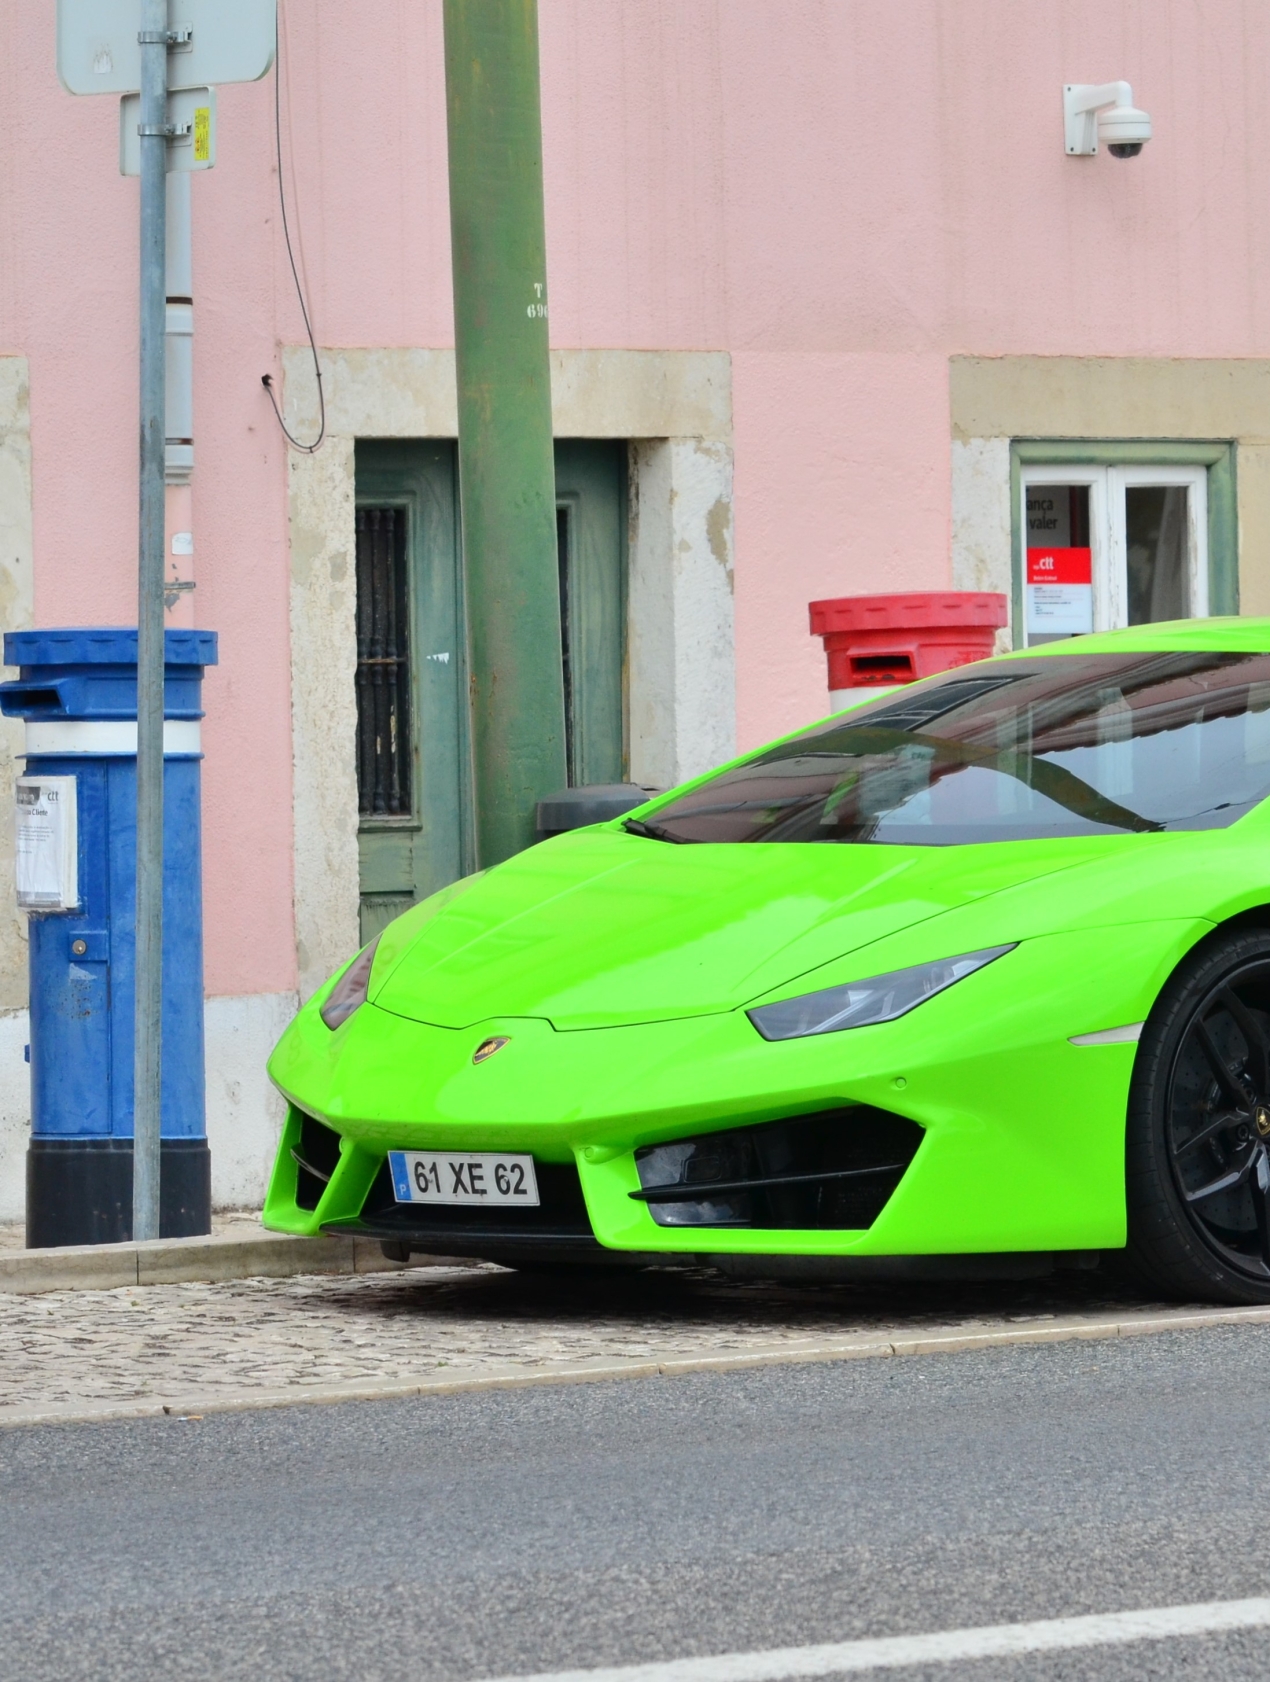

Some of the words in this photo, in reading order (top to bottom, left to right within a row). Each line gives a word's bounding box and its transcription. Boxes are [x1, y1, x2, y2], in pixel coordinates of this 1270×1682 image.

[534, 283, 542, 298] T
[1030, 516, 1058, 529] valer
[1040, 556, 1054, 570] ctt
[414, 1161, 441, 1193] 61
[449, 1163, 487, 1194] XE
[495, 1163, 528, 1195] 62
[400, 1184, 406, 1195] P
